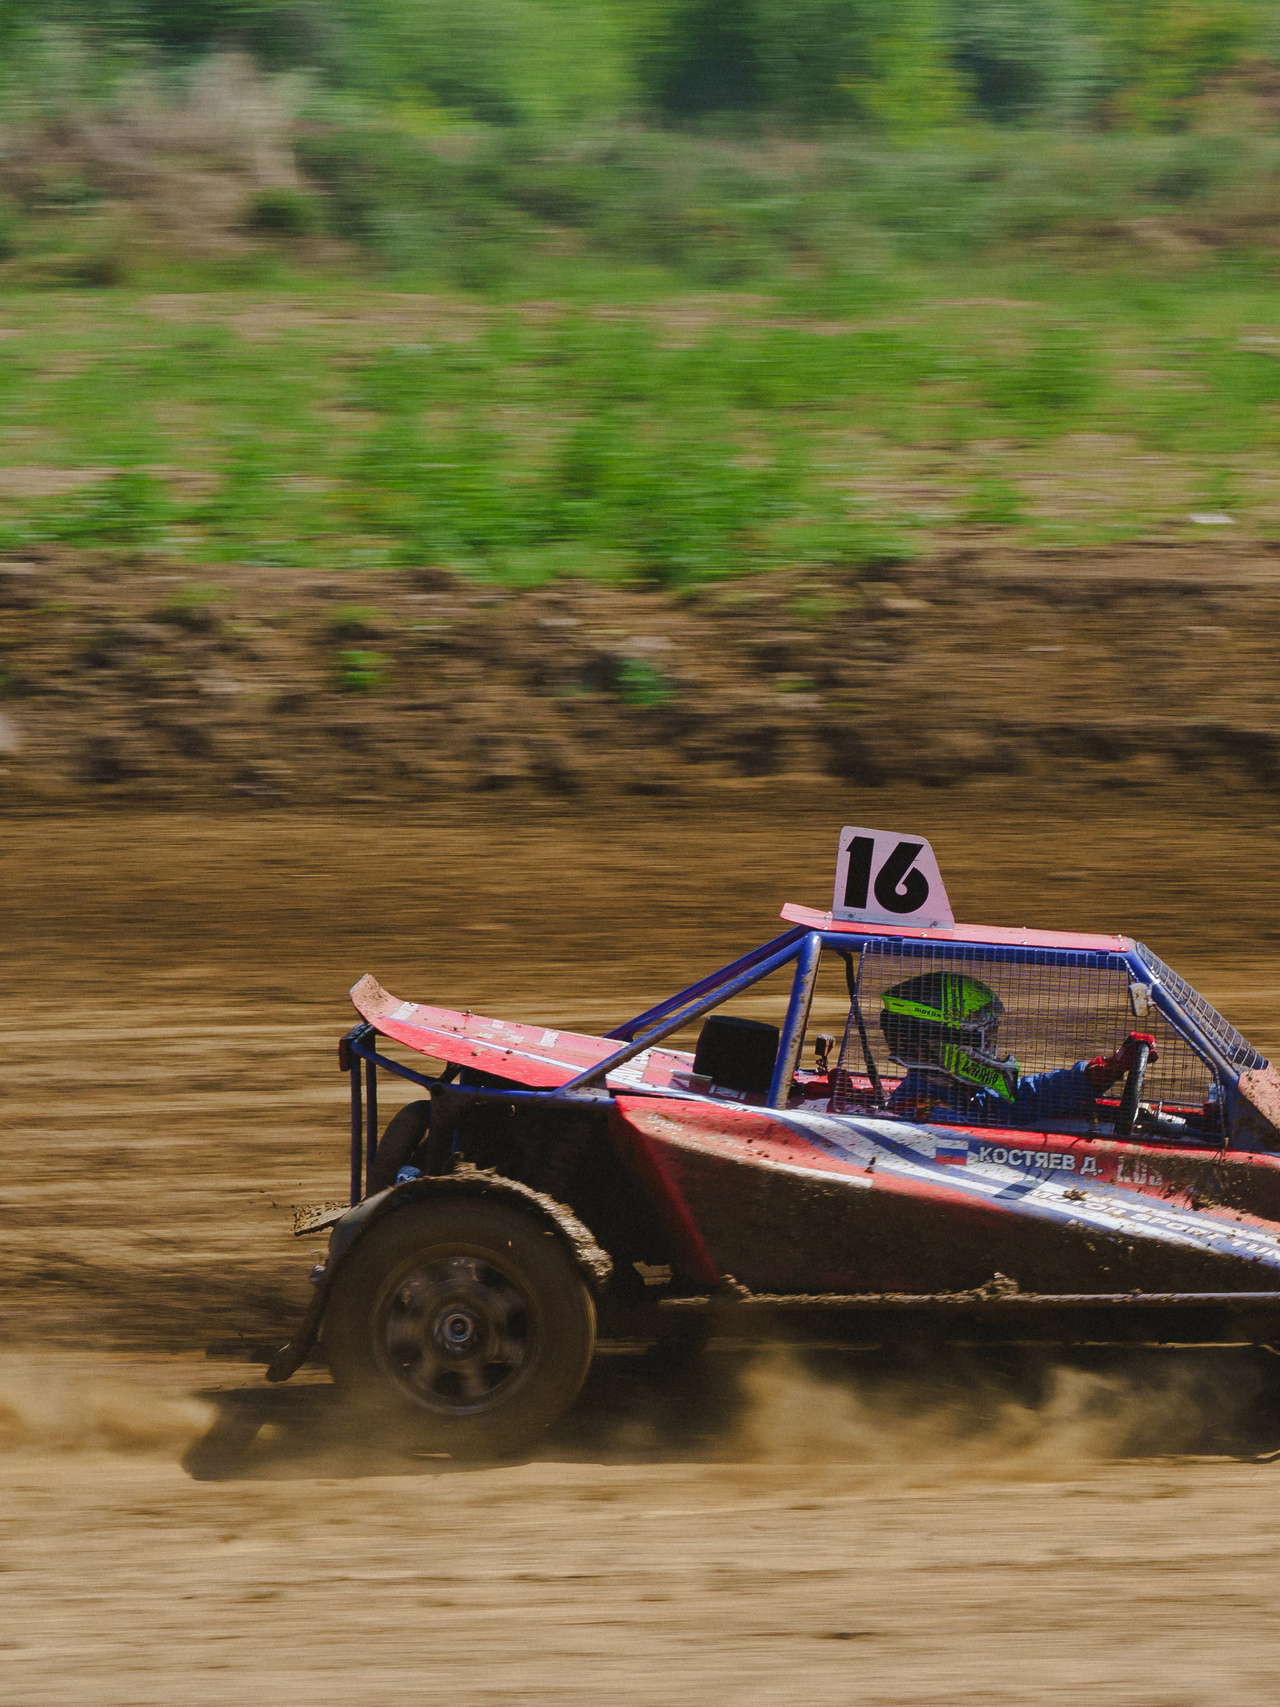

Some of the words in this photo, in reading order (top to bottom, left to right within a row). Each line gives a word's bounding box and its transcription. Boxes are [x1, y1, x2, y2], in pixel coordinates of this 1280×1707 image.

[844, 836, 929, 914] 16
[979, 1146, 1075, 1171] КОСТЯЕВ
[1080, 1156, 1103, 1176] Д.
[1030, 1189, 1127, 1219] MOTOR
[1130, 1213, 1227, 1240] SPORT
